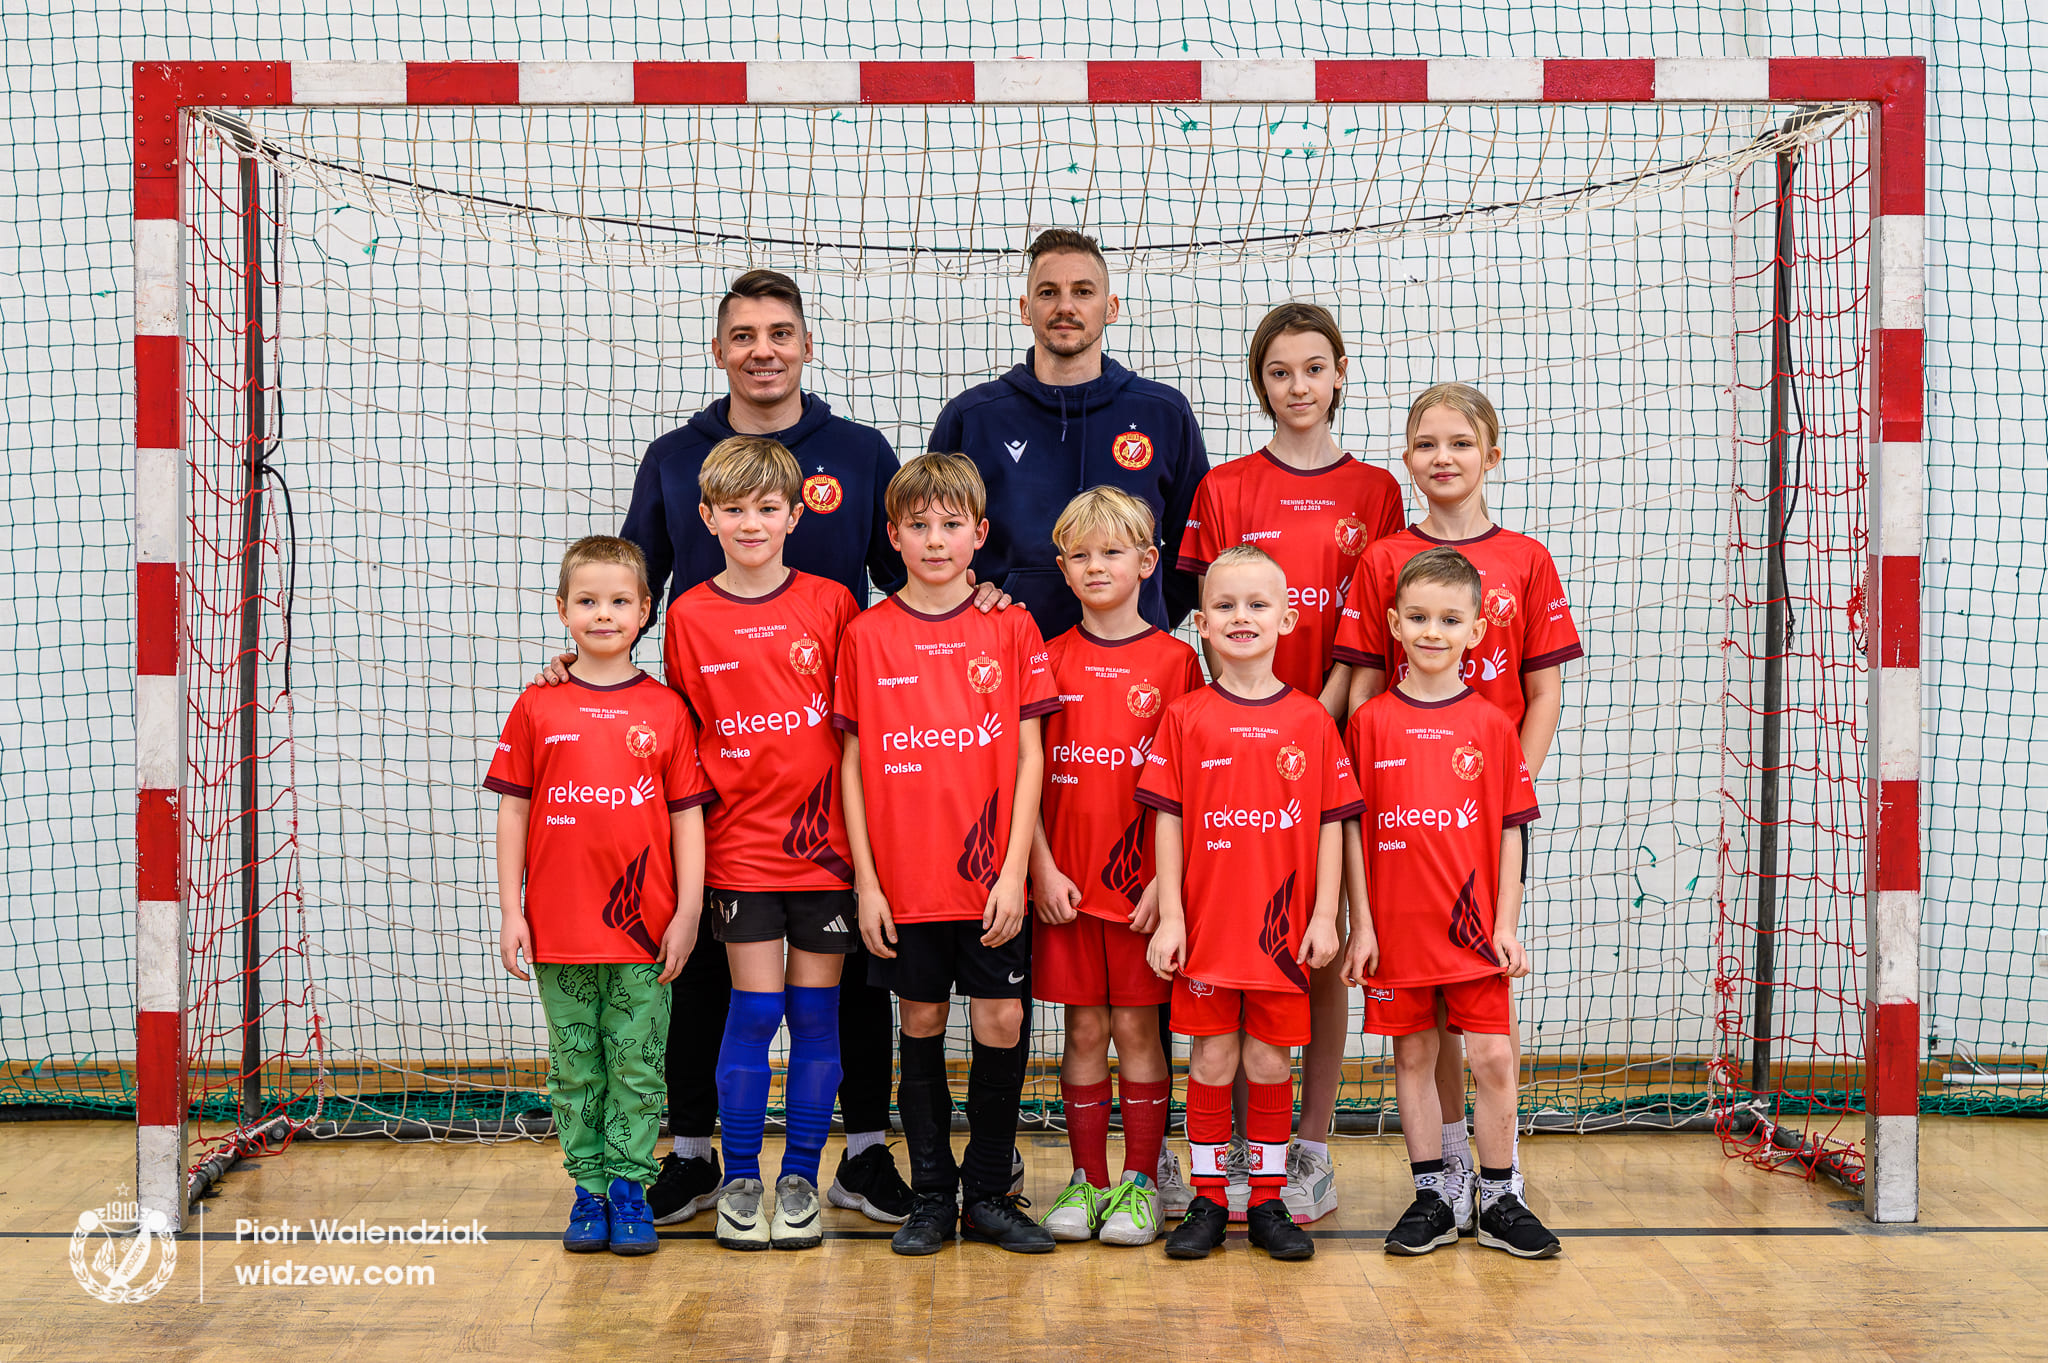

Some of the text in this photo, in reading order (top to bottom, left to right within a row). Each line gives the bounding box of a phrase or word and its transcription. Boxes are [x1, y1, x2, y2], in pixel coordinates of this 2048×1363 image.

[700, 661, 740, 675] snapwear
[878, 676, 918, 688] snapwear
[544, 734, 580, 745] snapwear
[882, 725, 974, 752] rekeep
[1053, 740, 1125, 770] rekeep
[884, 762, 922, 774] Polska
[1051, 774, 1078, 784] Polska
[548, 780, 626, 810] rekeep
[546, 814, 576, 826] Polska
[1204, 804, 1276, 833] rekeep
[1378, 805, 1452, 832] rekeep
[1378, 840, 1407, 852] Polska
